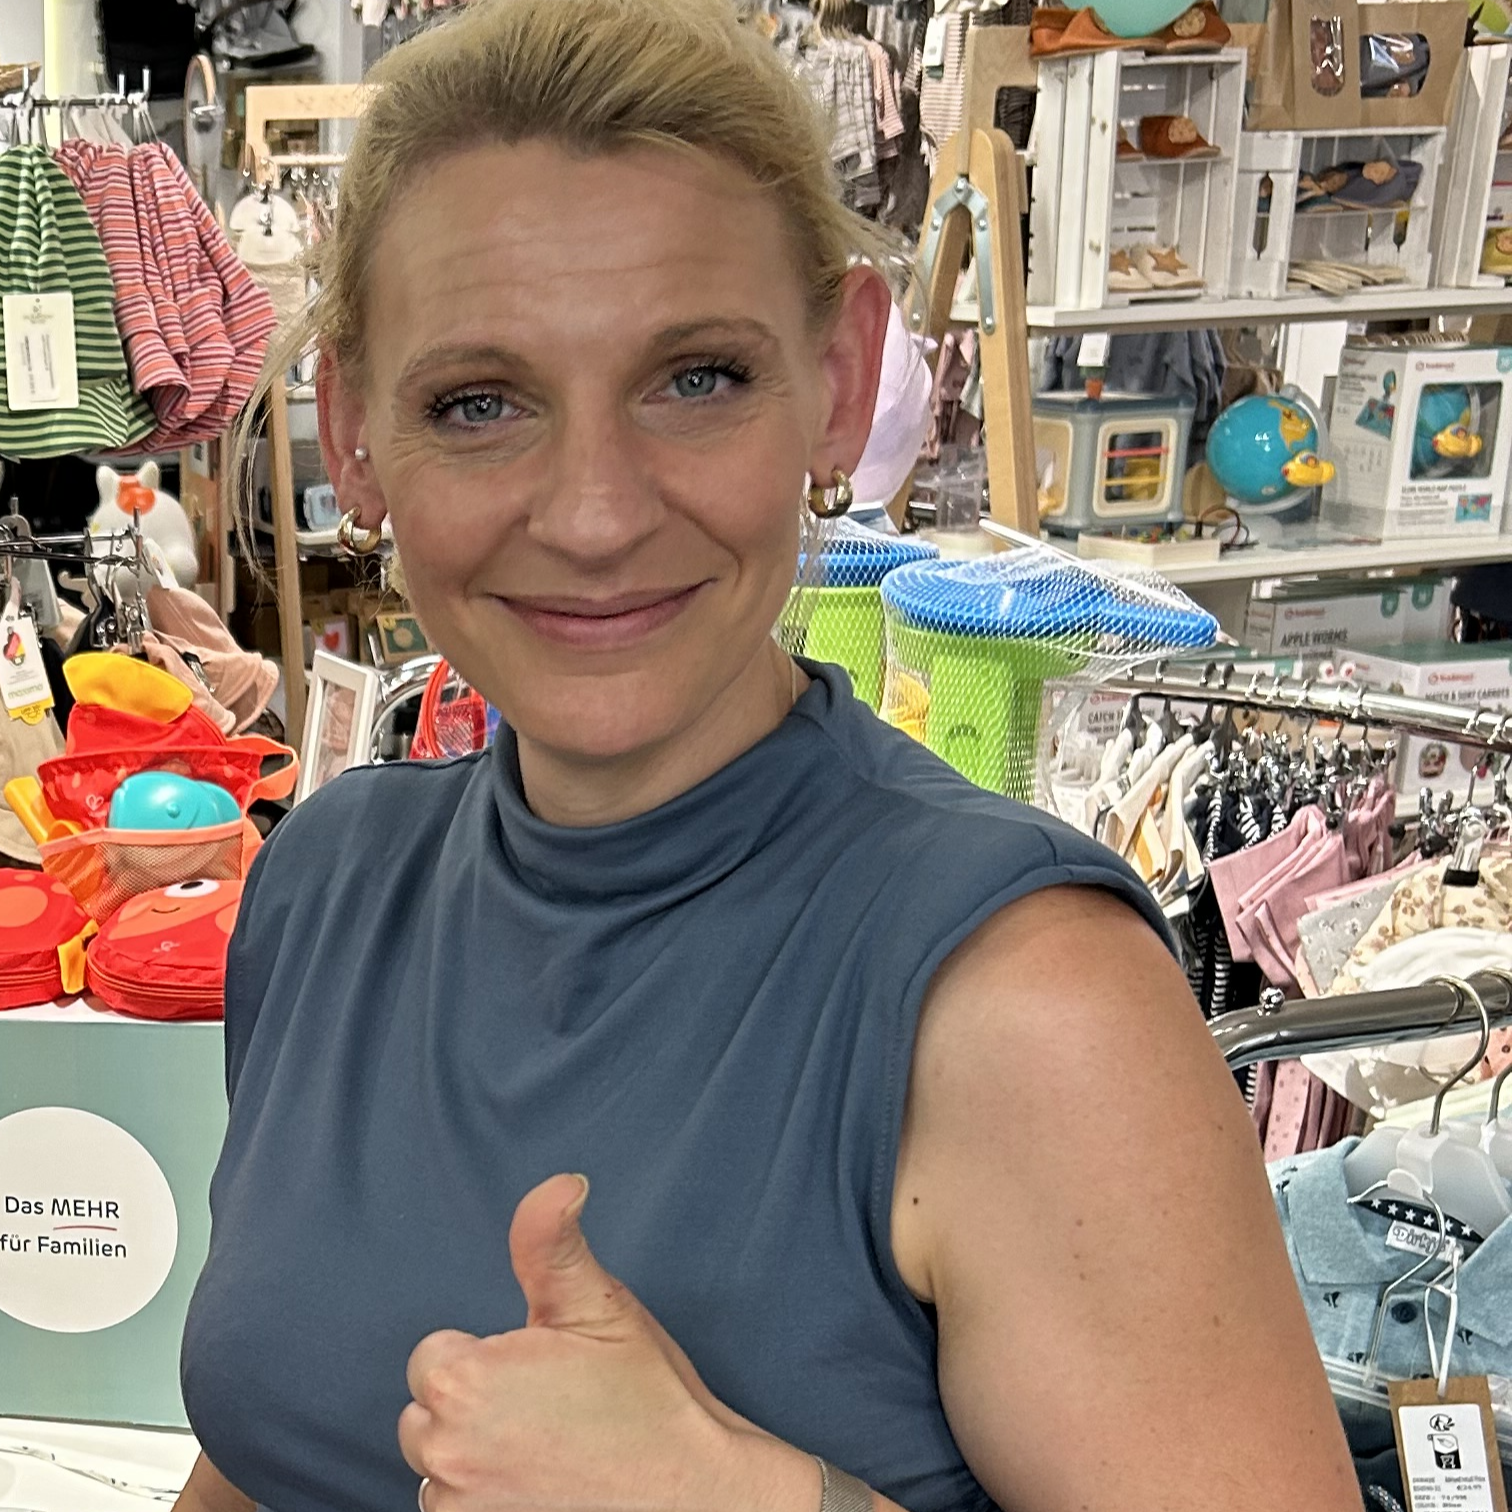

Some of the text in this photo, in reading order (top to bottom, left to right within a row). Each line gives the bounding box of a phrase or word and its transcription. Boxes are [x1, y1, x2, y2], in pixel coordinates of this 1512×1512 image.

[5, 1196, 120, 1219] Das MEHR
[0, 1233, 127, 1258] für Familien
